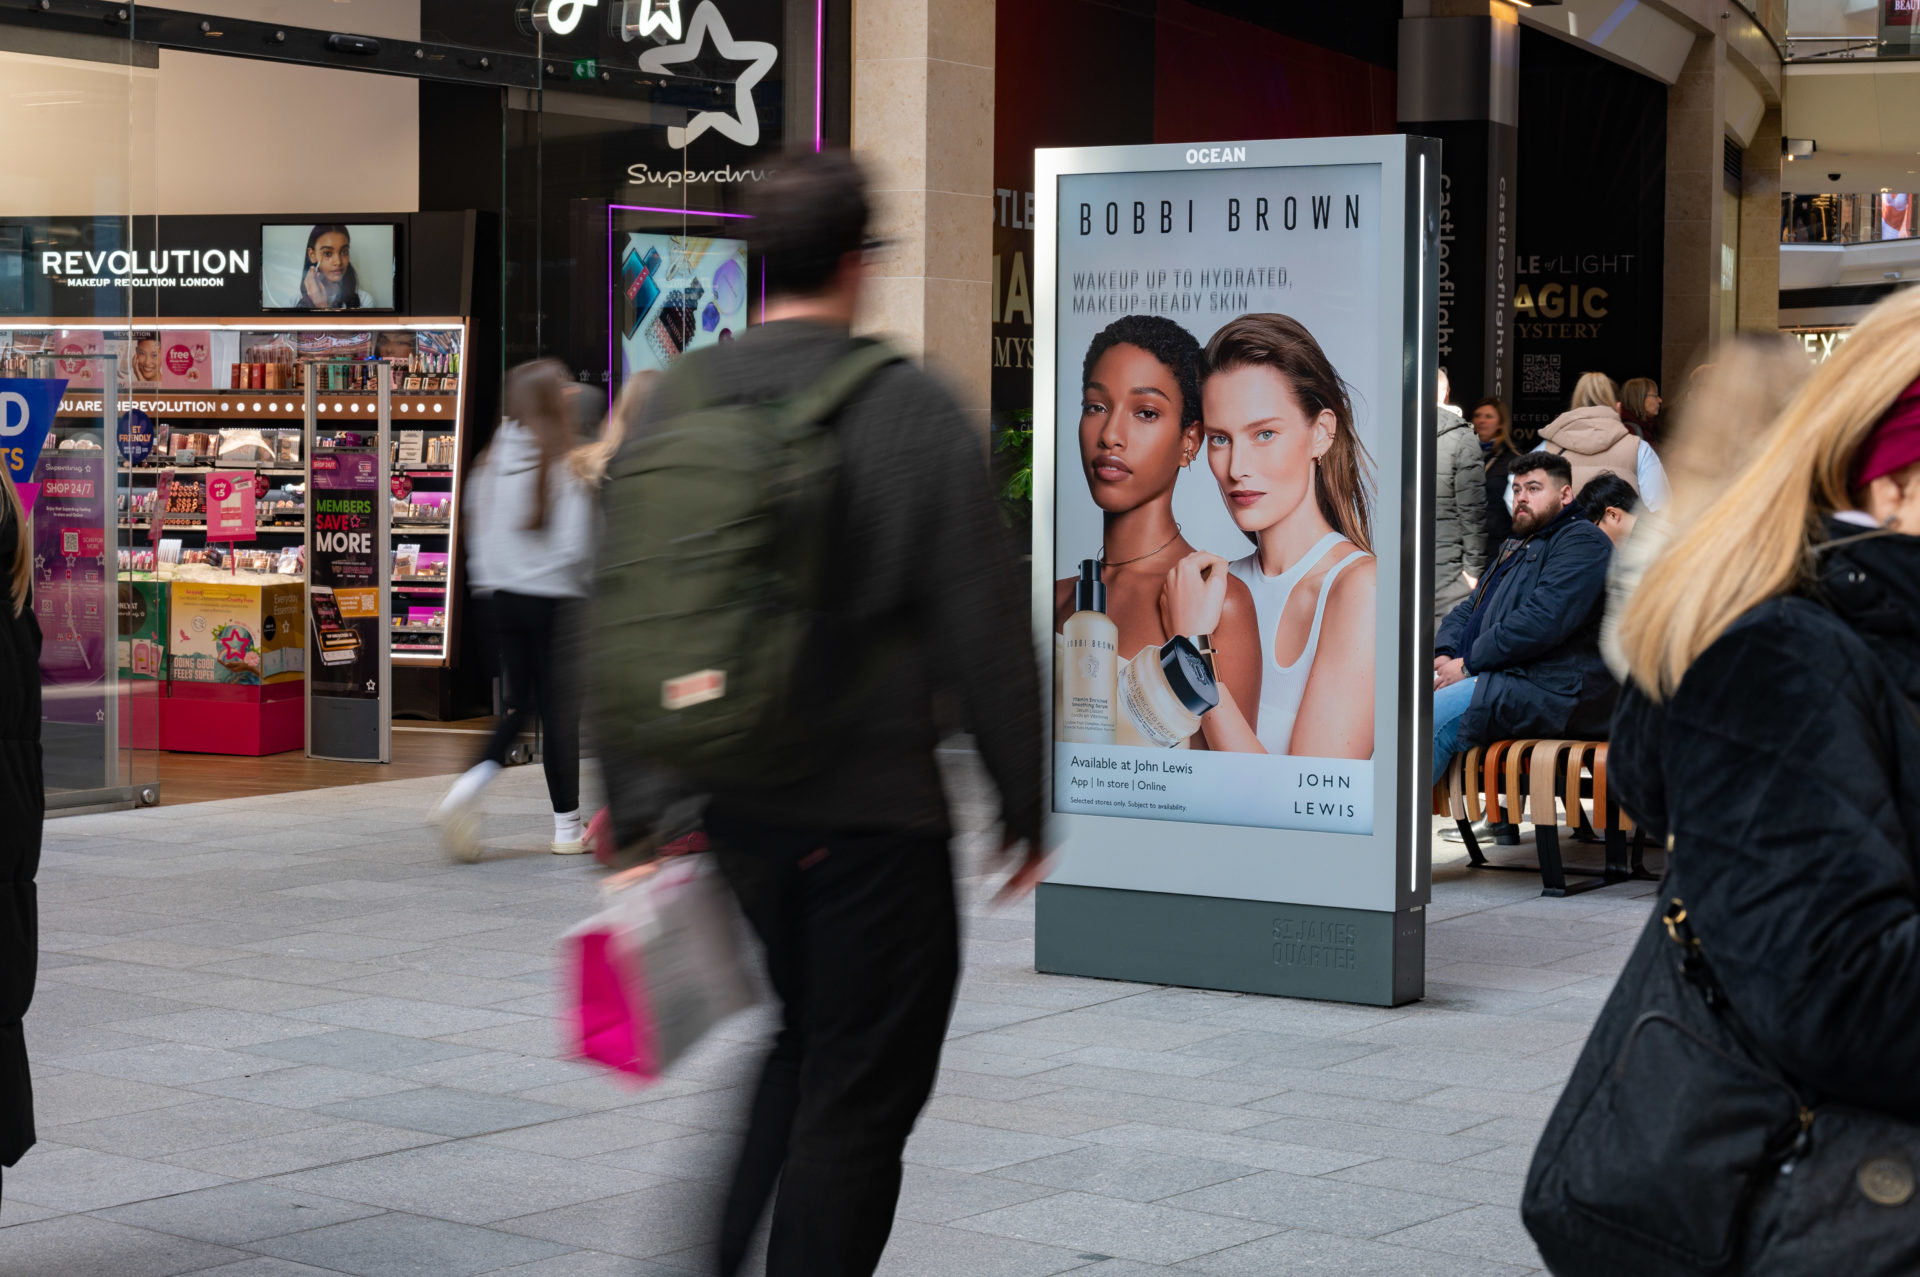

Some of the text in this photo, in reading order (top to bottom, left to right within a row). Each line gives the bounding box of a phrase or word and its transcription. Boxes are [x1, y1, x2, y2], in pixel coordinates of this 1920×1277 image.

[1186, 147, 1246, 164] OCEAN
[1080, 194, 1360, 235] BOBBI BROWN
[42, 250, 250, 275] REVOLUTION
[1560, 254, 1636, 274] LIGHT
[67, 277, 224, 287] MAKEUP REOLUTION LONDON
[1073, 267, 1294, 291] WAKEUP UP TO HYDRATED,
[1210, 290, 1248, 312] SKIN
[1514, 281, 1609, 319] AGIC
[1513, 322, 1604, 339] YSTERY
[170, 349, 190, 359] free
[57, 400, 73, 412] OU
[75, 400, 102, 412] ARE
[45, 464, 83, 473] Superdrug
[46, 482, 91, 495] SHOP 24/7
[216, 489, 225, 497] £5
[316, 499, 371, 513] MEMBERS
[316, 514, 349, 531] SAVE
[316, 531, 371, 553] MORE
[174, 657, 215, 669] DOING GOOD
[174, 669, 215, 680] FEELS SUPER
[1071, 756, 1193, 774] Available at John Lewis
[1071, 776, 1166, 791] App In store Online
[1299, 773, 1351, 789] JOHN
[1070, 796, 1094, 805] Selected
[1128, 801, 1149, 809] Subject
[1294, 801, 1354, 818] LEWIS
[1296, 919, 1357, 947] JAMES
[1272, 942, 1358, 971] QUARTER
